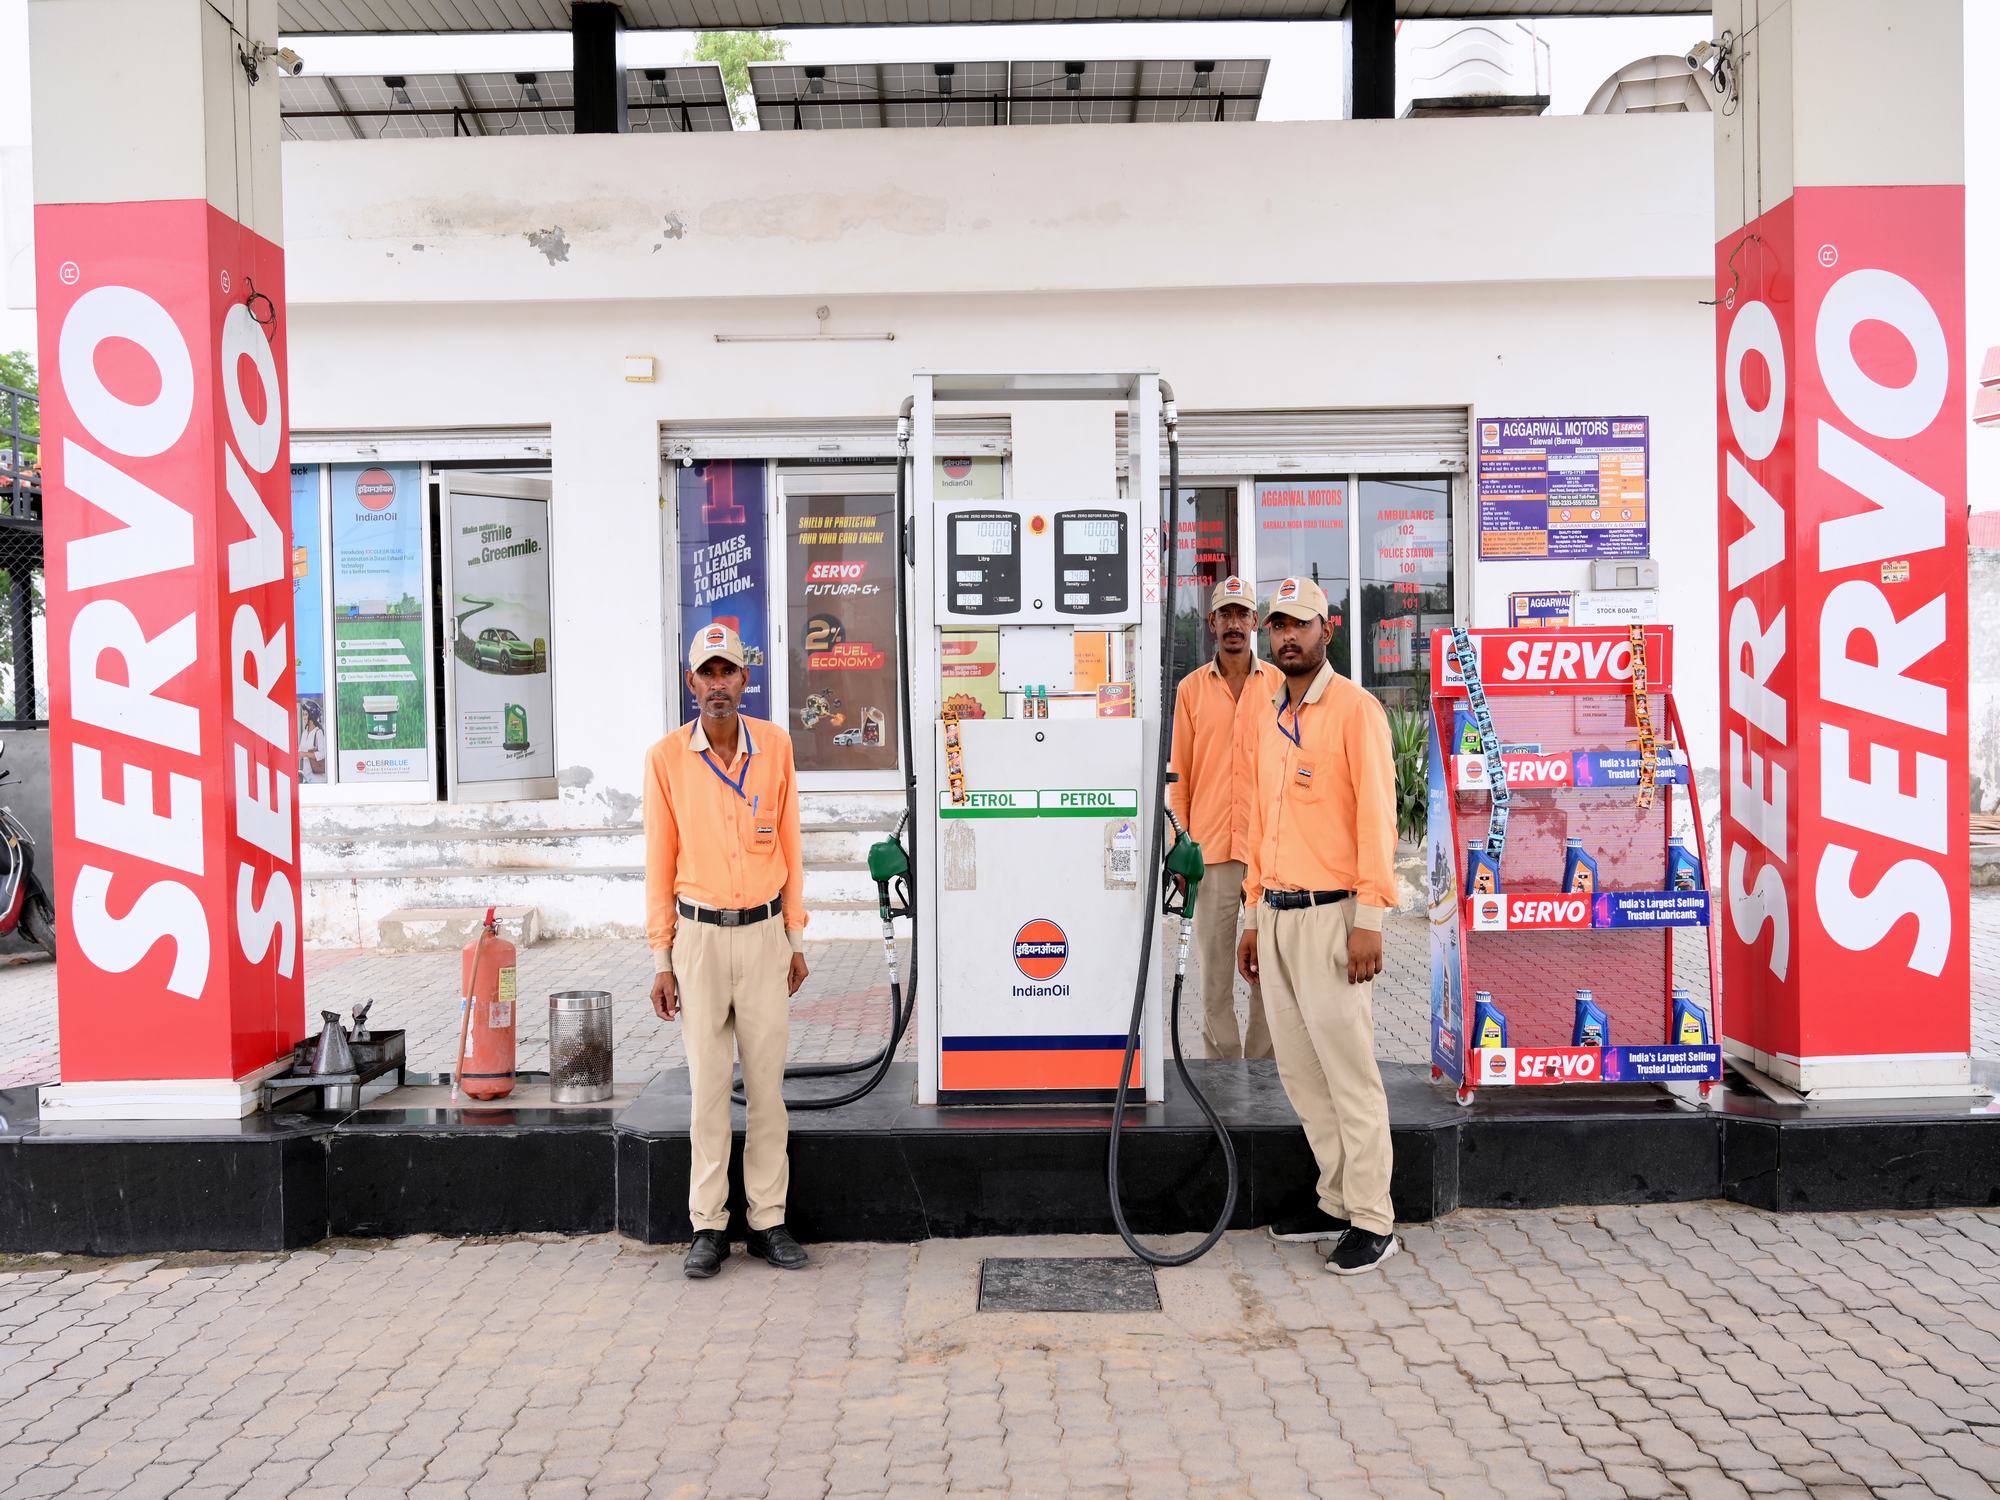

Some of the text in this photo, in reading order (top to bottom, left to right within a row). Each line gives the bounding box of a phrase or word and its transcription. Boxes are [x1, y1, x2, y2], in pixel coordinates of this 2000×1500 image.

[1503, 421, 1609, 437] AGGARWAL MOTORS
[1620, 423, 1643, 431] SERVO
[291, 465, 308, 476] ack
[1261, 489, 1343, 508] AGGARWAL MOTORS
[355, 512, 398, 522] IndianOil
[1377, 509, 1435, 521] AMBULANCE
[799, 515, 877, 529] SHIELD OF PROTECTION
[1263, 520, 1287, 529] BARNALA
[1303, 520, 1317, 528] ROAD
[481, 525, 512, 544] smile
[1397, 524, 1415, 535] 102
[859, 531, 884, 544] ENGINE
[467, 538, 542, 567] with Greenmile.
[693, 534, 746, 565] IT TAKES
[1379, 547, 1434, 558] POLICE STATION
[694, 546, 752, 579] A LEADER
[1194, 553, 1226, 563] BARNALA
[812, 564, 861, 579] SERVO
[1399, 562, 1416, 573] 100
[693, 565, 738, 593] TO RUN
[694, 575, 755, 608] A NATION.
[804, 583, 881, 596] FUTURA-G+
[1393, 582, 1420, 594] FIRE
[1402, 598, 1419, 609] 101
[1530, 598, 1570, 608] AGGARWAL
[1814, 268, 1952, 977] SERVO
[59, 285, 211, 999] SERVO
[222, 303, 297, 980] SERVO
[1725, 300, 1788, 983] SERVO
[833, 645, 869, 657] FUEL
[1501, 640, 1634, 681] SERVO
[1599, 757, 1625, 768] India's
[1607, 769, 1635, 779] Trusted
[962, 793, 1017, 807] PETROL
[1060, 792, 1116, 806] PETROL
[1619, 897, 1705, 909] India's Largest Selling
[1510, 900, 1586, 923] SERVO
[1626, 910, 1697, 920] Trusted Lubricants
[1015, 942, 1065, 957] इंडियनऑयल
[1012, 985, 1070, 997] IndianOil
[1629, 1051, 1716, 1063] India's Largest Selling
[1517, 1054, 1595, 1078] SERVO
[1636, 1063, 1708, 1074] Trusted Lubricants
